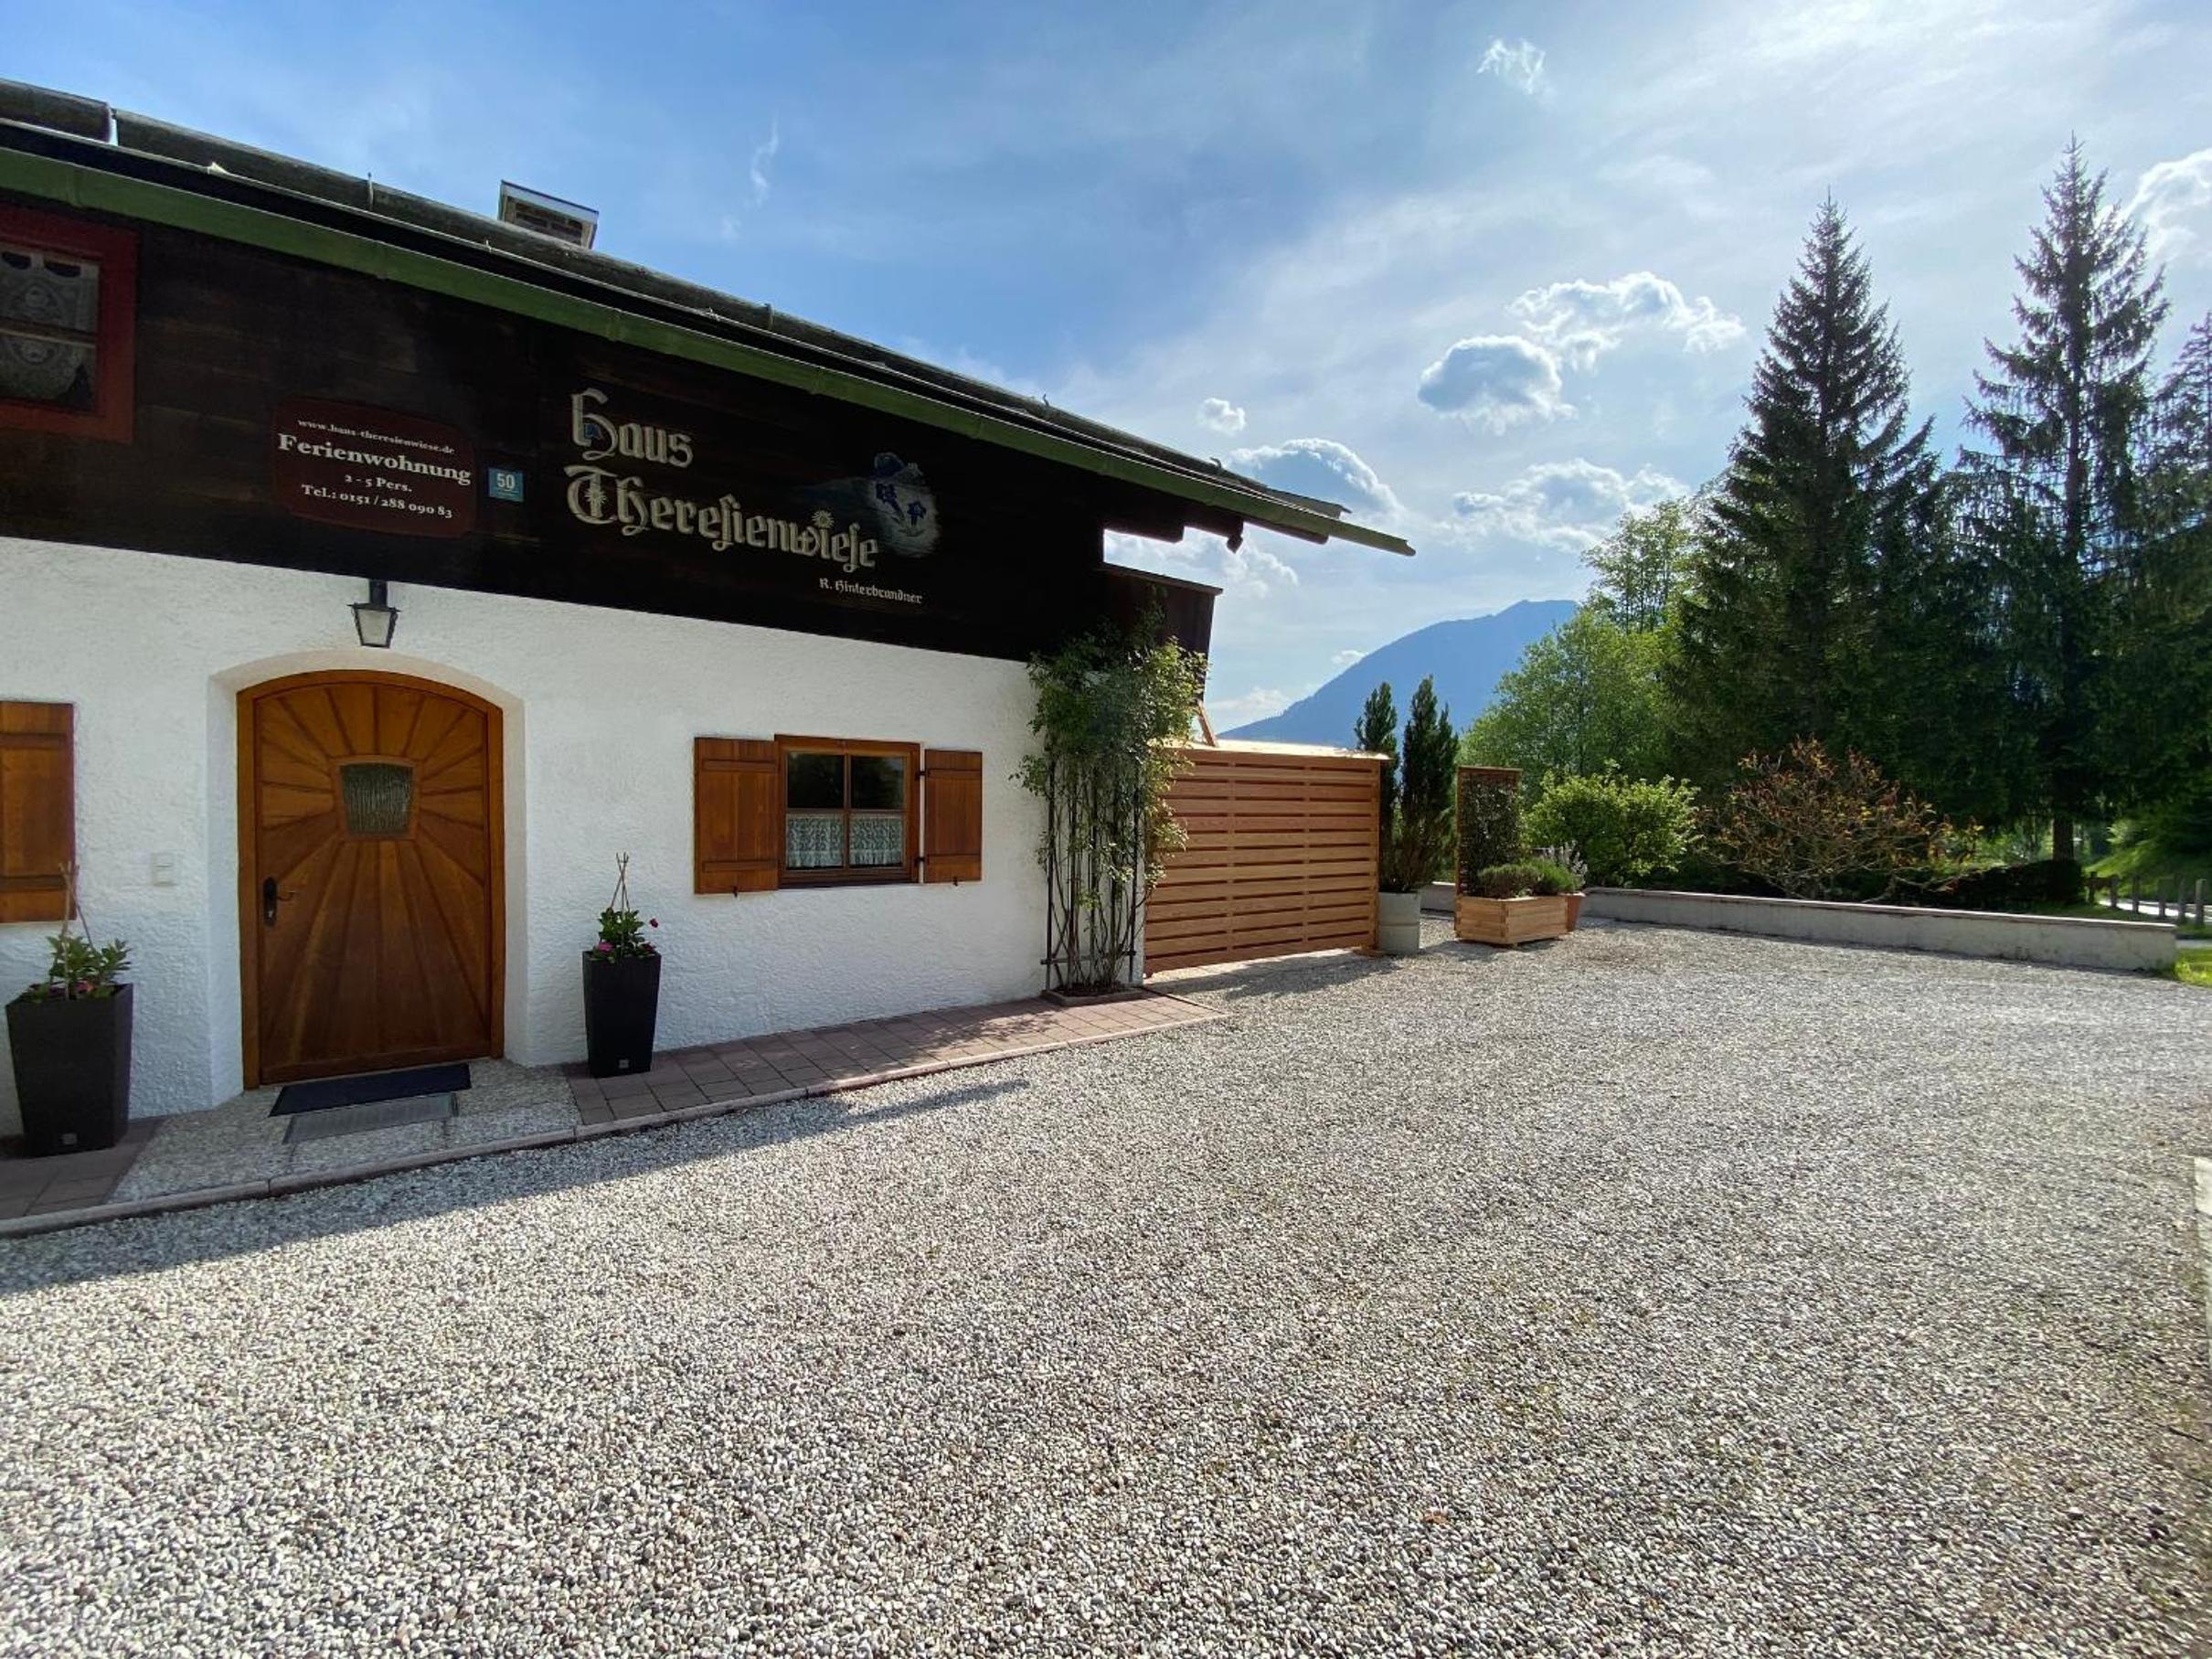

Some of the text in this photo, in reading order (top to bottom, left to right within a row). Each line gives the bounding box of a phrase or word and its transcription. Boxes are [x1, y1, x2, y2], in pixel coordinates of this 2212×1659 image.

[570, 388, 694, 469] Haus
[277, 432, 472, 485] Ferienwohnung
[344, 473, 353, 483] 2
[365, 478, 373, 488] 5
[376, 476, 413, 493] Pers.
[496, 472, 516, 490] 50
[301, 484, 337, 499] Tel.:
[339, 493, 370, 505] 0151
[380, 497, 405, 510] 288
[408, 502, 434, 516] 090
[437, 505, 453, 519] 83
[819, 577, 833, 590] R.
